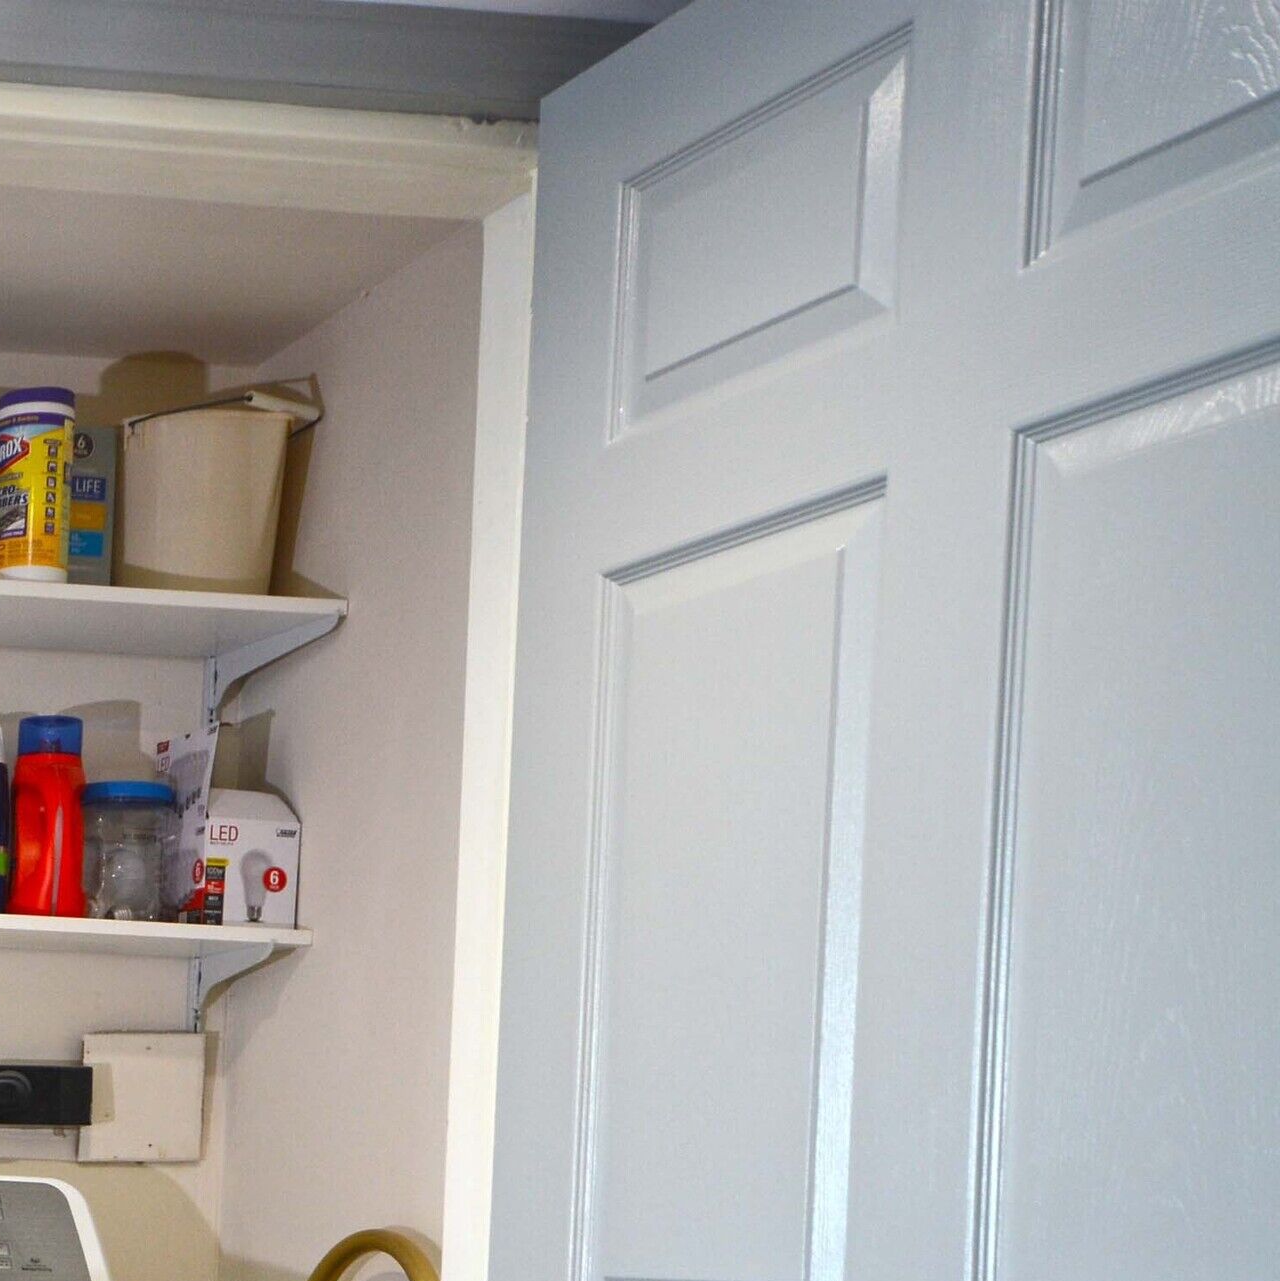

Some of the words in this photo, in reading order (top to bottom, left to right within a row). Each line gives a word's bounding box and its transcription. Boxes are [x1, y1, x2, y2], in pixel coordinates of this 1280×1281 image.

[77, 437, 85, 448] 6
[75, 480, 101, 494] LIFE
[209, 825, 238, 842] LED
[269, 870, 279, 883] 6
